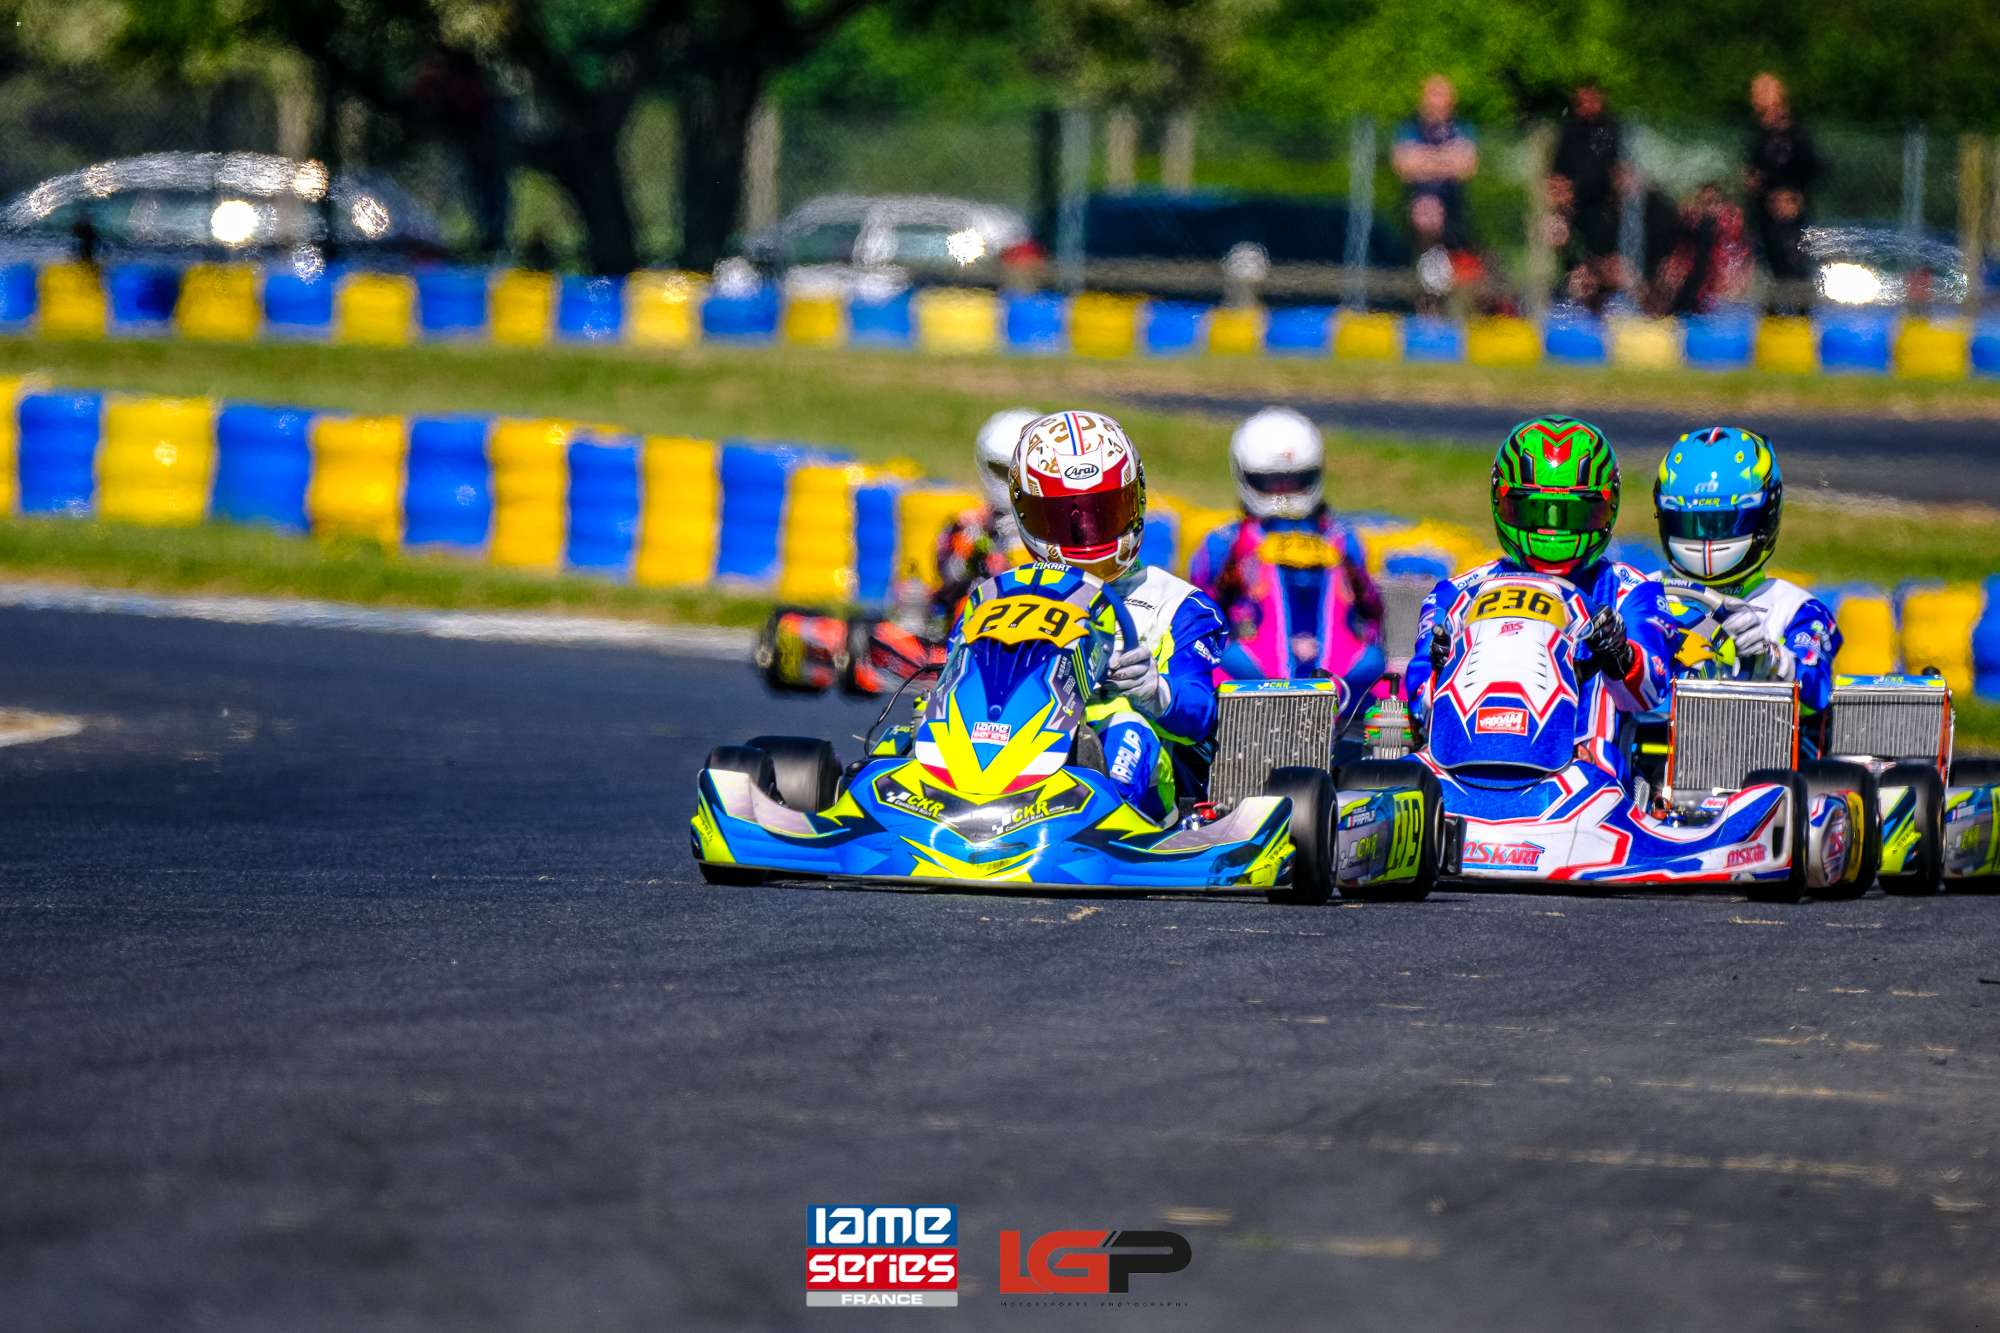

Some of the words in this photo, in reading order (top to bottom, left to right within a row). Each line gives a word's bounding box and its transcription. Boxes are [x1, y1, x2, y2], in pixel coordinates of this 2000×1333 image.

[1070, 464, 1095, 477] Arai
[1476, 589, 1554, 618] 236
[976, 603, 1070, 638] 279
[908, 796, 945, 818] CKR
[1012, 800, 1051, 823] CKR
